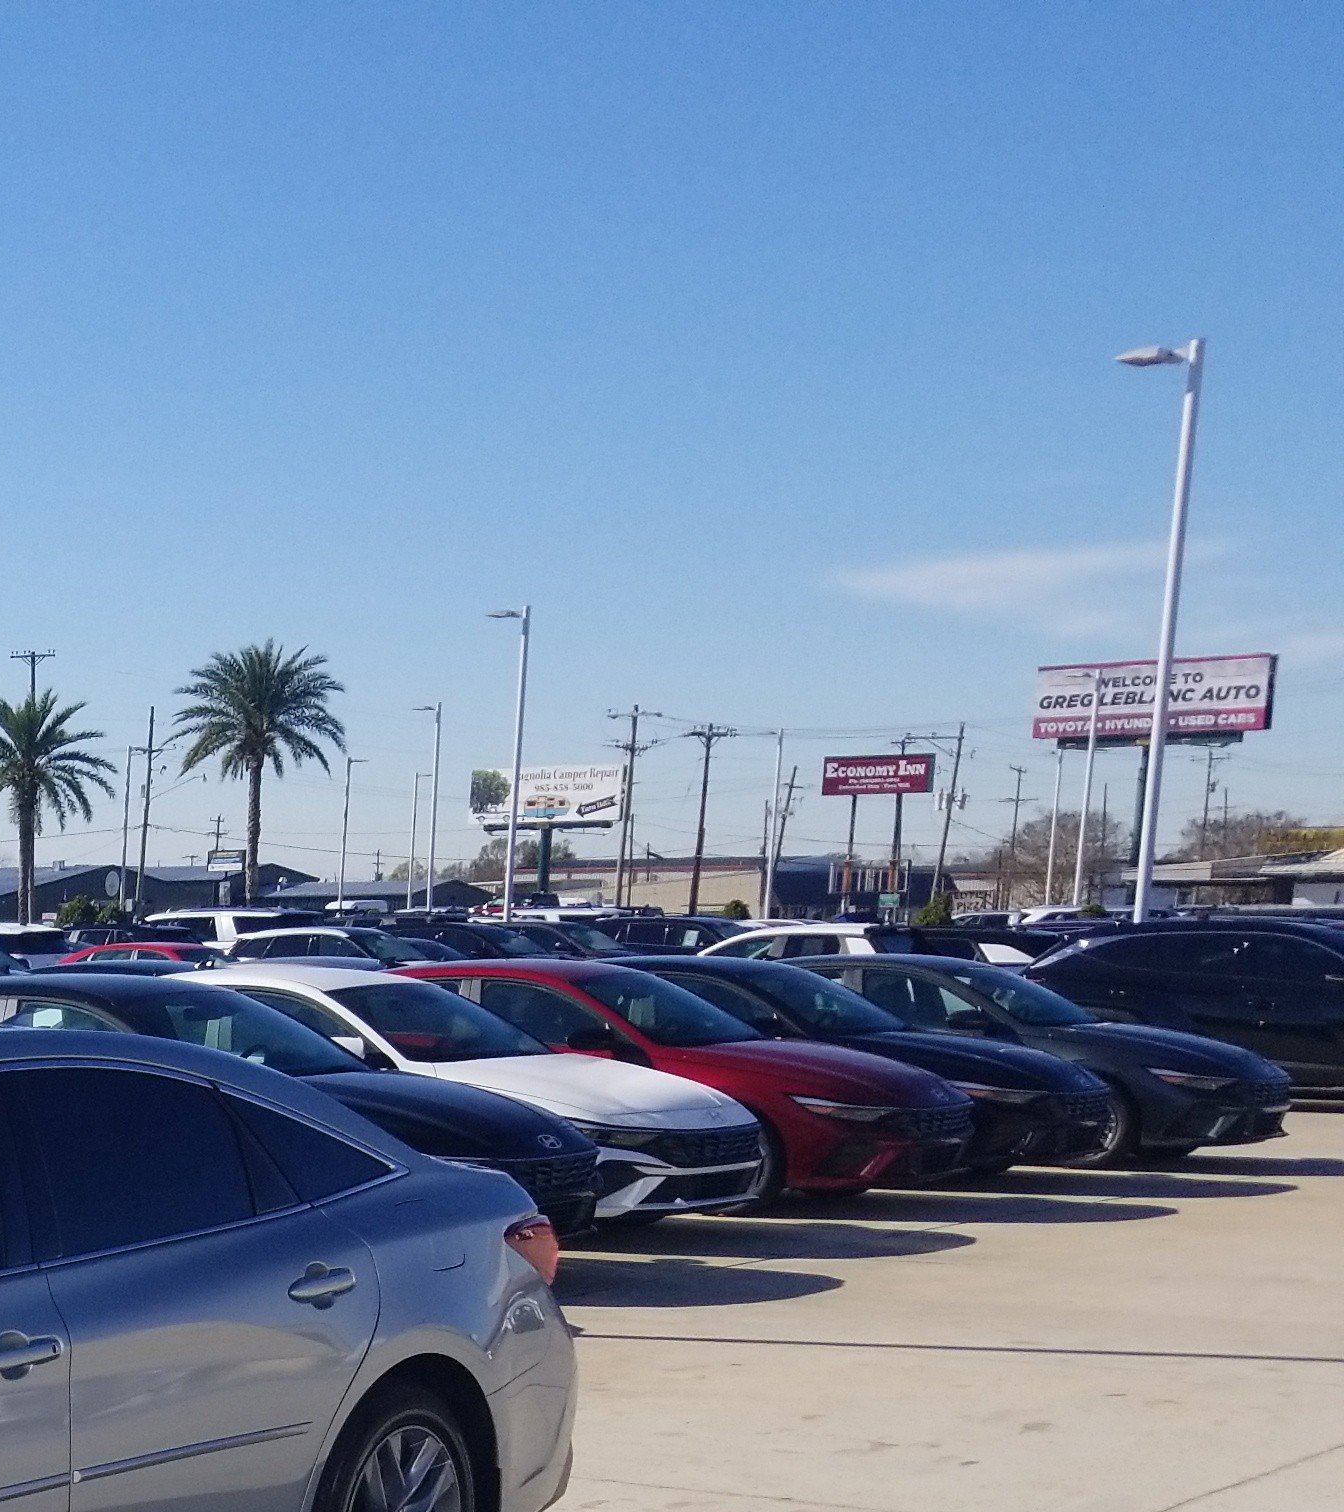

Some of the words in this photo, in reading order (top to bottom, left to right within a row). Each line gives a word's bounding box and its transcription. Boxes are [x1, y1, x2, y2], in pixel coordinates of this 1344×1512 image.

[1098, 673, 1178, 689] WELCOE
[1182, 672, 1203, 684] TO
[1039, 692, 1094, 709] GREG
[1097, 687, 1196, 707] LEBLNC
[1199, 684, 1261, 702] AUTO
[1038, 720, 1093, 733] TOYOTA
[1105, 717, 1153, 730] HYUND
[1178, 714, 1215, 726] USED
[1217, 713, 1256, 725] CARS
[520, 769, 551, 784] agnolia
[553, 768, 588, 782] Camper
[589, 767, 619, 782] Repair
[825, 762, 897, 778] ECONOMY
